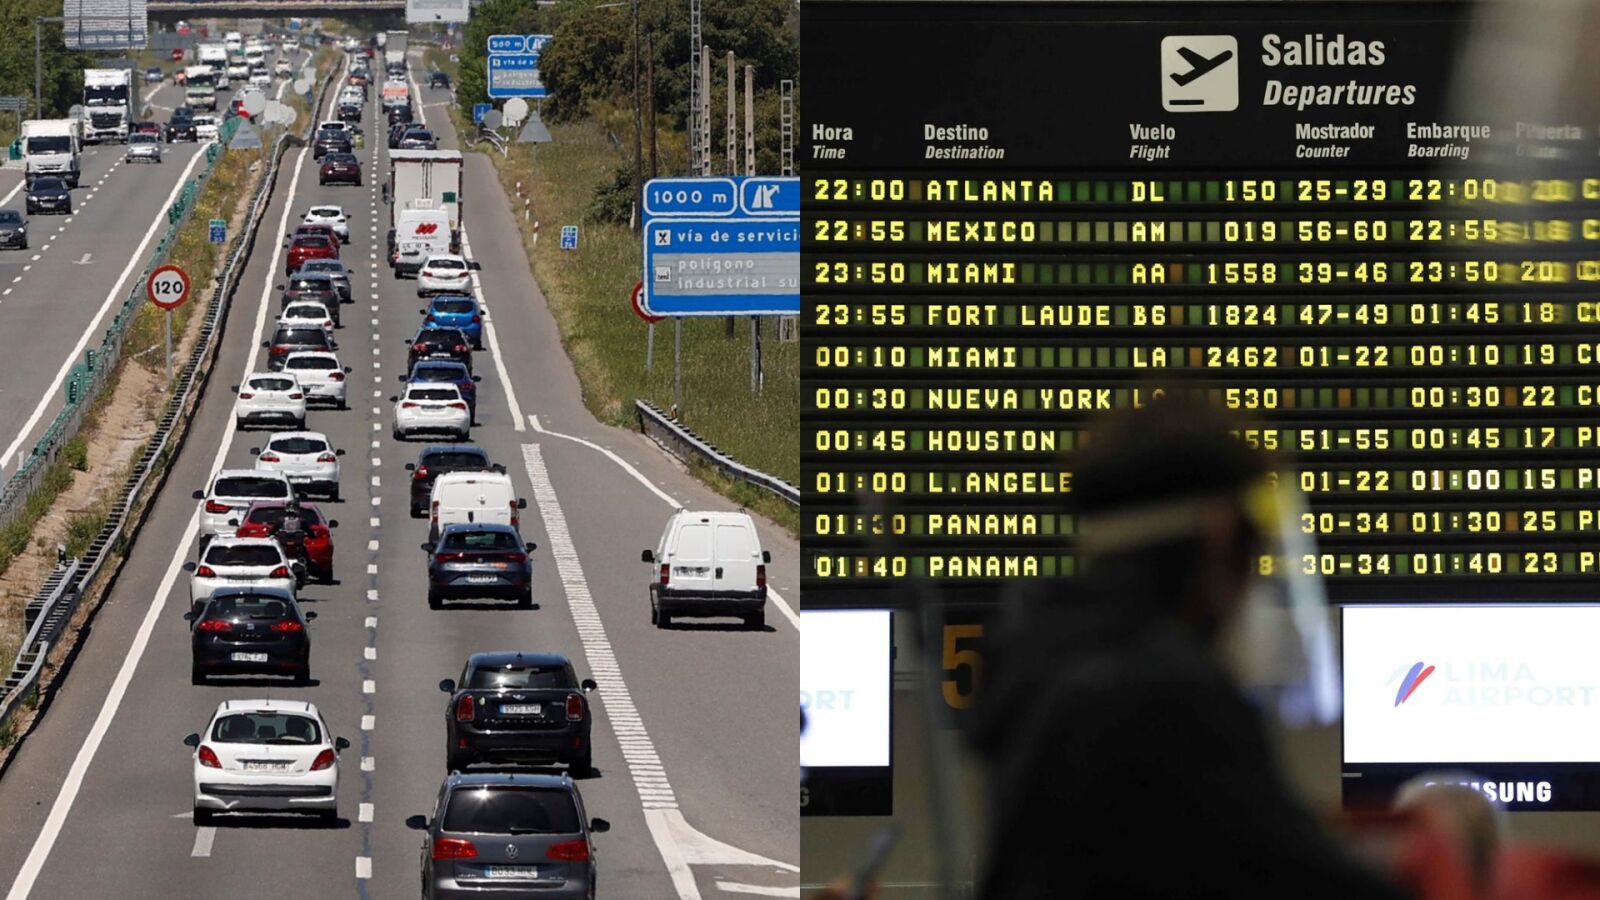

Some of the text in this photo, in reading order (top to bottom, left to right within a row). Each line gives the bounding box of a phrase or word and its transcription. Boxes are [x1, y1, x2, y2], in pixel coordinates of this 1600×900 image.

[1261, 34, 1386, 67] Salidas
[1263, 79, 1417, 111] Departures
[812, 123, 853, 141] Hora
[924, 123, 989, 141] Destino
[1129, 123, 1176, 140] Vuelo
[1295, 122, 1376, 140] Mostrador
[1406, 122, 1491, 142] Embarque
[812, 145, 846, 159] Time
[925, 145, 1005, 159] Destination
[1129, 145, 1171, 161] Flight
[1295, 144, 1350, 158] Counter
[1407, 143, 1470, 160] Boarding
[653, 190, 727, 204] 1000 m
[815, 179, 904, 201] 22:00
[927, 180, 1053, 202] ATLANTA
[1132, 181, 1165, 202] DL
[1225, 180, 1276, 201] 150
[1298, 180, 1387, 201] 25-29
[1408, 179, 1497, 201] 22:00
[678, 228, 800, 242] vía de servici
[815, 220, 904, 241] 22:55
[927, 221, 1035, 242] MEXICO
[1132, 221, 1165, 242] AM
[1224, 221, 1276, 242] 019
[1298, 220, 1387, 242] 56-60
[1409, 219, 1498, 241] 22:55
[678, 257, 754, 273] polígono
[815, 262, 905, 283] 23:50
[928, 262, 1015, 284] MIAMI
[1132, 263, 1165, 284] AA
[1207, 263, 1276, 284] 1558
[1299, 262, 1387, 283] 39-46
[1409, 261, 1498, 282] 23:50
[154, 280, 183, 294] 120
[678, 276, 766, 289] industrial
[815, 302, 1600, 326] 23:55 FORT LAUDE B6 1824 47-49 01:45 18 C
[816, 343, 1600, 368] 00:10 MIAMI LA 2462 01-22 00:10 19 C
[816, 388, 905, 409] 00:30
[928, 388, 1017, 409] NUEVA
[1040, 388, 1111, 409] YORK
[1226, 388, 1277, 409] 530
[1411, 386, 1500, 408] 00:30
[1522, 385, 1555, 406] 22
[1578, 385, 1600, 406] C
[816, 430, 906, 451] 00:45
[928, 430, 1055, 451] HOUSTON
[1300, 429, 1389, 450] 51-55
[1411, 428, 1500, 449] 00:45
[1524, 427, 1555, 448] 17
[1578, 426, 1600, 447] P
[816, 472, 906, 493] 01:00
[1301, 470, 1389, 492] 01-22
[1412, 469, 1500, 491] 01:00
[1524, 468, 1556, 490] 15
[1578, 468, 1600, 489] P
[816, 510, 1600, 535] 01:30 PANAMA 30-34 01:30 25 P
[816, 556, 906, 577] 01:40
[929, 556, 1038, 577] PANAMA
[1302, 555, 1390, 575] 30-34
[1413, 553, 1502, 574] 01:40
[1524, 552, 1557, 573] 23
[1580, 551, 1600, 573] P
[941, 624, 984, 710] 5
[1444, 662, 1538, 682] LIMA
[1442, 686, 1596, 707] AIRPORT
[1425, 781, 1553, 803] SUNG
